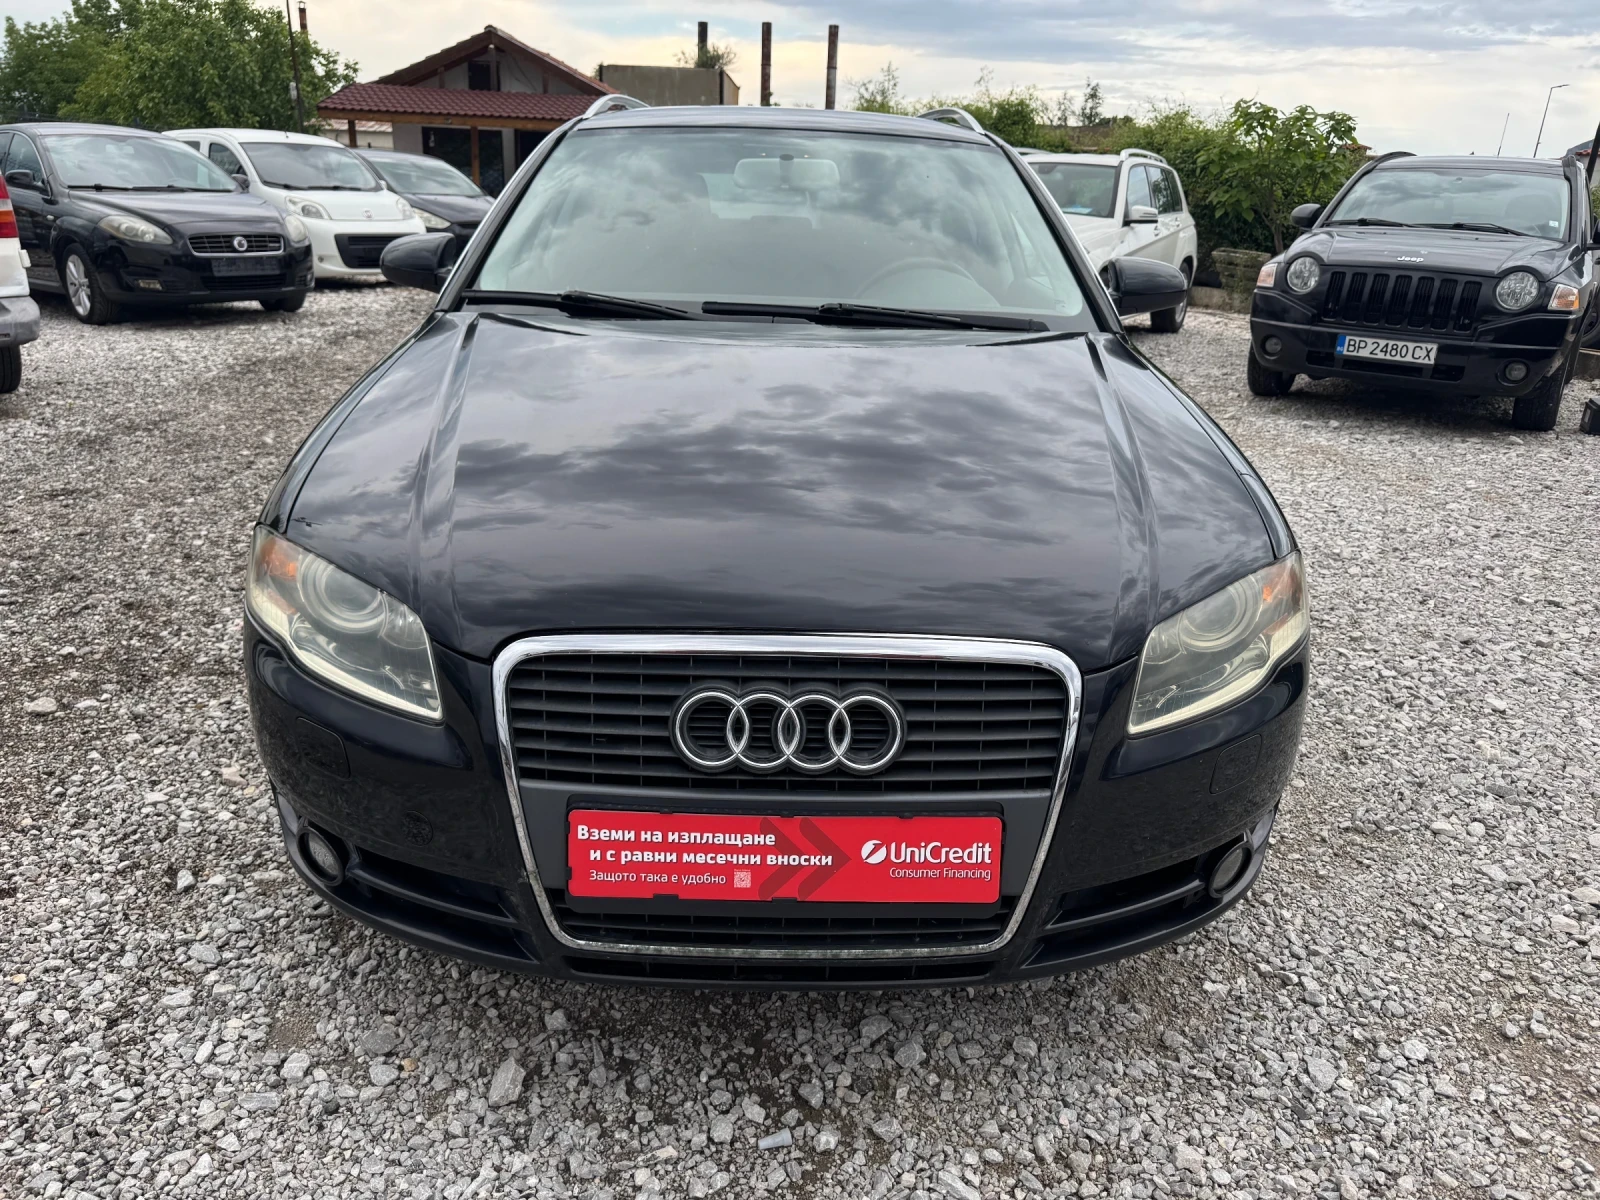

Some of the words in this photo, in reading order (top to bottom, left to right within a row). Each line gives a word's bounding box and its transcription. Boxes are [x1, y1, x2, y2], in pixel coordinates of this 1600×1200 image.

[1346, 338, 1368, 354] BP
[1369, 341, 1409, 359] 2480
[1411, 345, 1434, 361] CX
[577, 825, 636, 842] Вземи
[640, 830, 663, 843] на
[667, 831, 776, 848] изплащане
[589, 849, 601, 861] и
[606, 850, 616, 861] с
[620, 850, 678, 865] равни
[682, 852, 761, 865] месечни
[766, 854, 833, 866] вноски
[890, 842, 992, 864] UniCredit
[589, 869, 637, 882] Защото
[640, 873, 668, 882] така
[671, 874, 679, 882] е
[681, 872, 726, 885] удобно
[889, 867, 941, 878] Consumer
[943, 867, 991, 881] Financing
